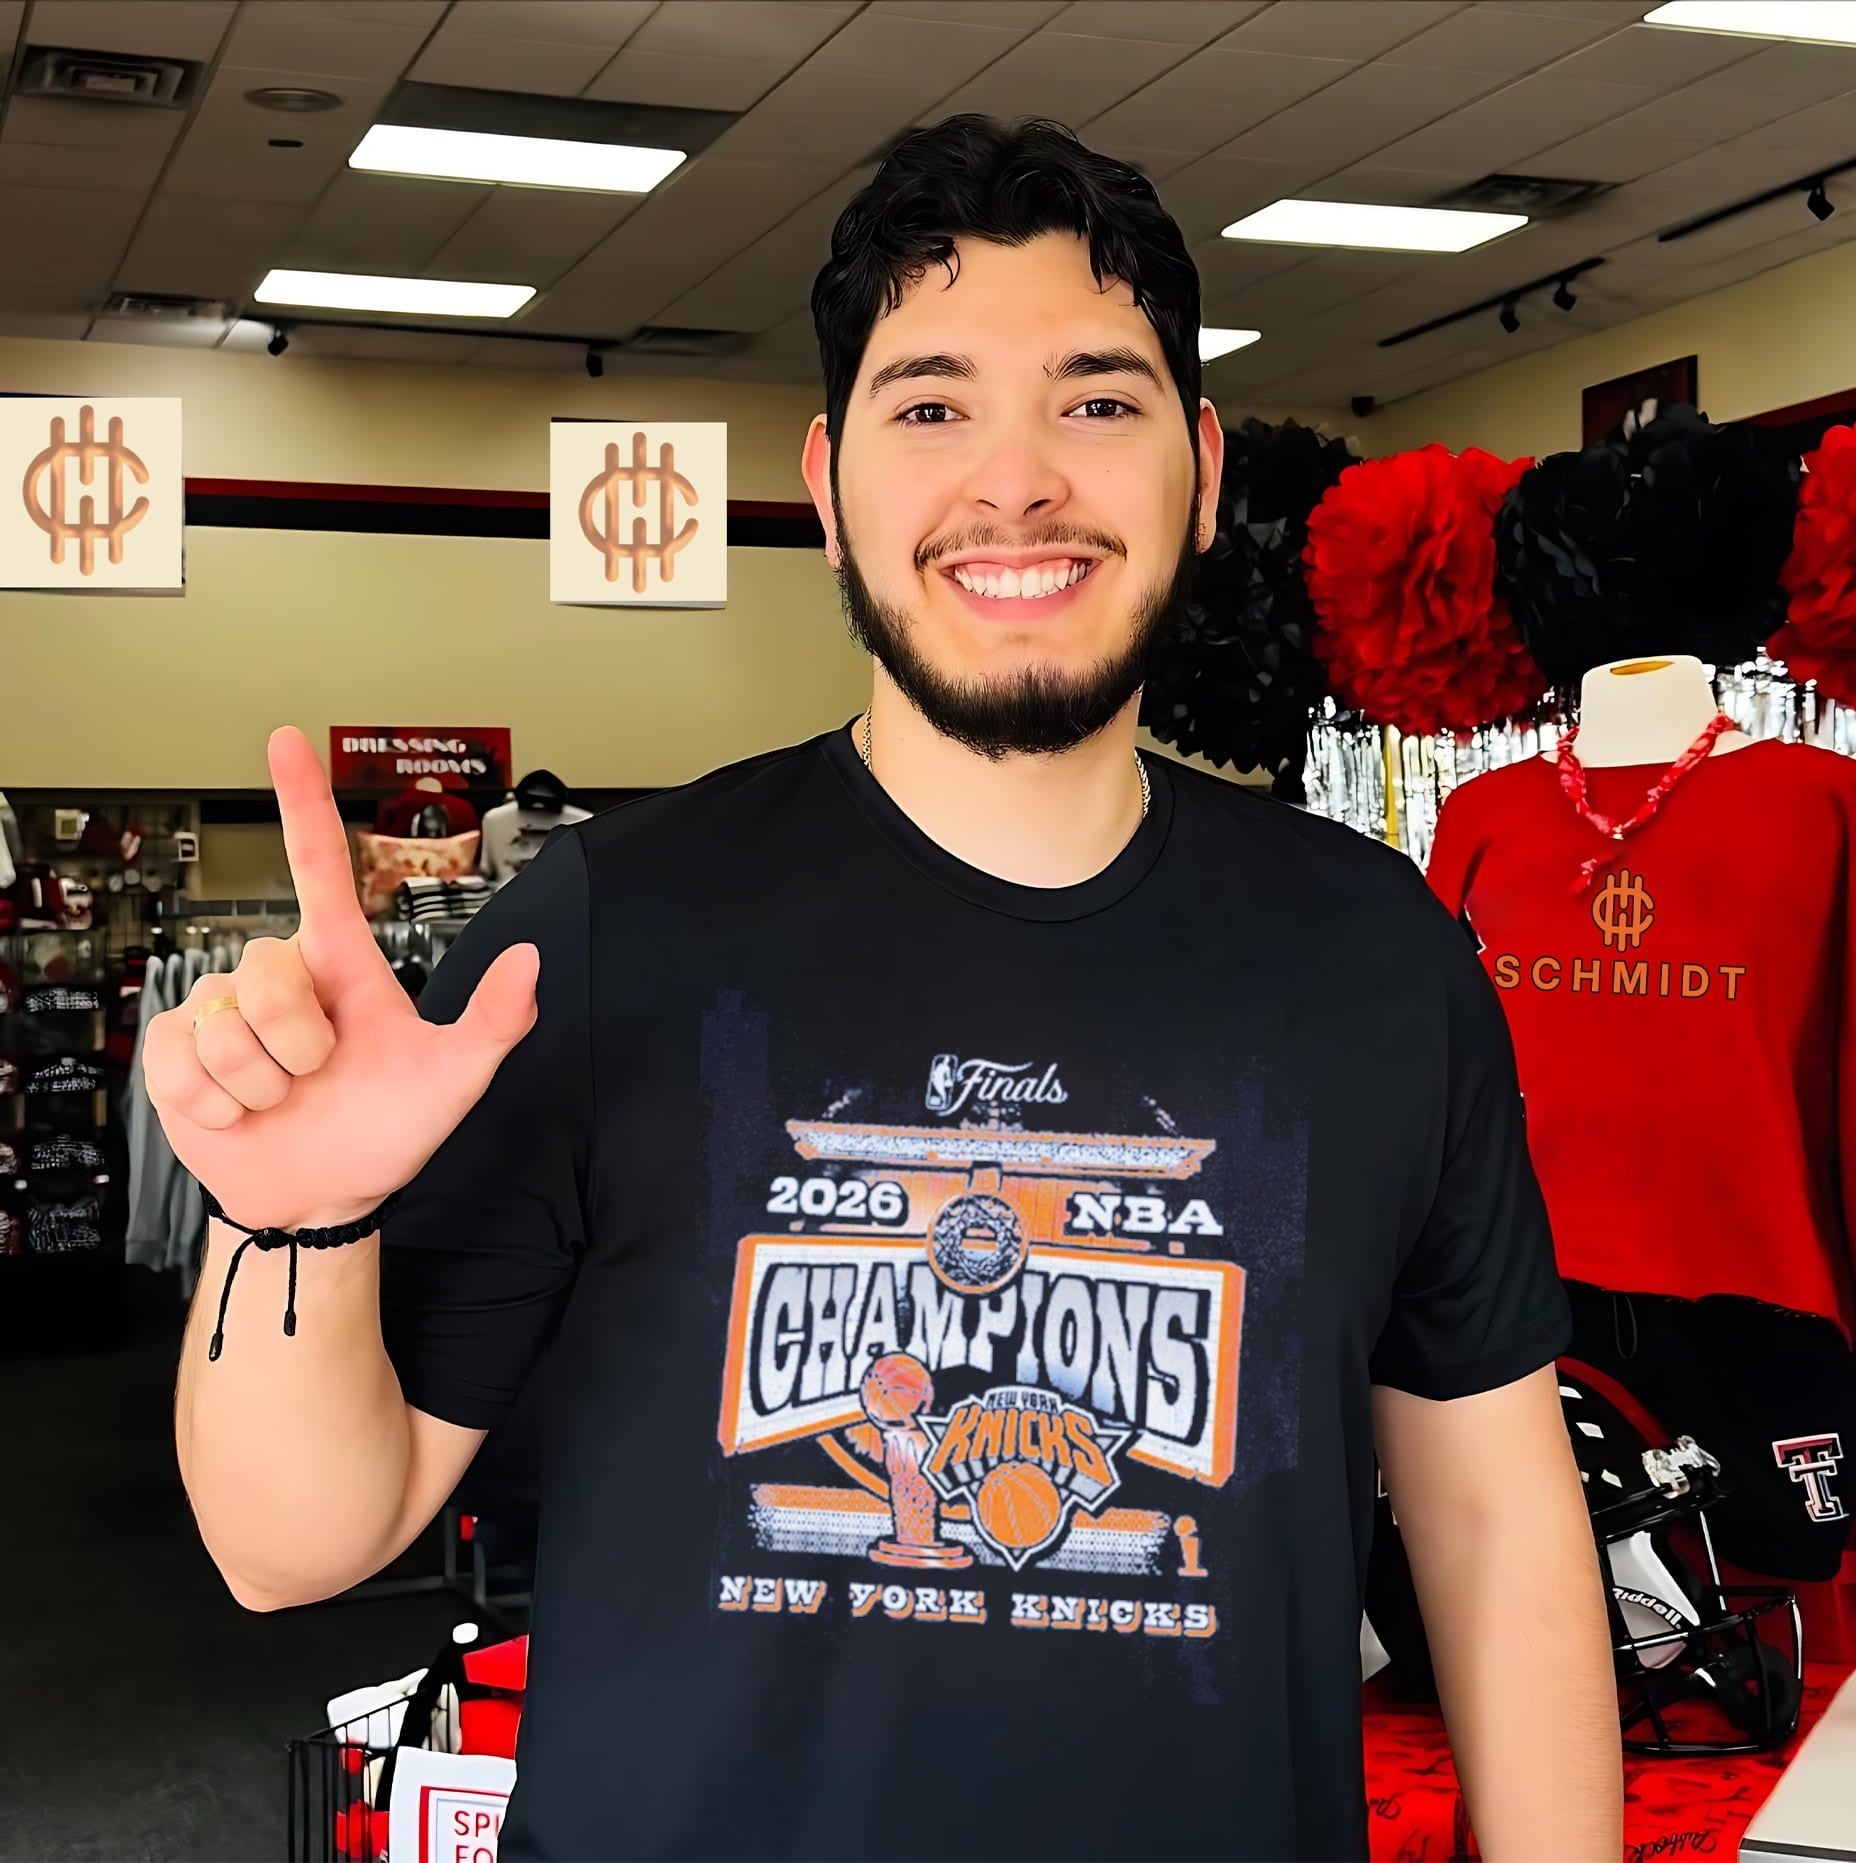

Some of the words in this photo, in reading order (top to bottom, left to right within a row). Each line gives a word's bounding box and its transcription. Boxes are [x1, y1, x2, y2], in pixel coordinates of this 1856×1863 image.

[342, 737, 467, 754] DRESSING
[396, 758, 487, 775] ROOMS
[1494, 953, 1747, 1001] SCHMIDT
[937, 1058, 1069, 1117] Finals
[767, 1176, 904, 1220] 2026
[1071, 1192, 1224, 1236] NBA
[754, 1263, 1212, 1446] CHAMPIONS
[985, 1390, 1019, 1411] NEW
[1020, 1390, 1060, 1413] YORK
[929, 1403, 1113, 1488] KNICKS
[718, 1575, 828, 1614] NEW
[848, 1582, 987, 1624] YORK
[1010, 1593, 1217, 1639] KNICKS
[1612, 1587, 1683, 1627] Riddell
